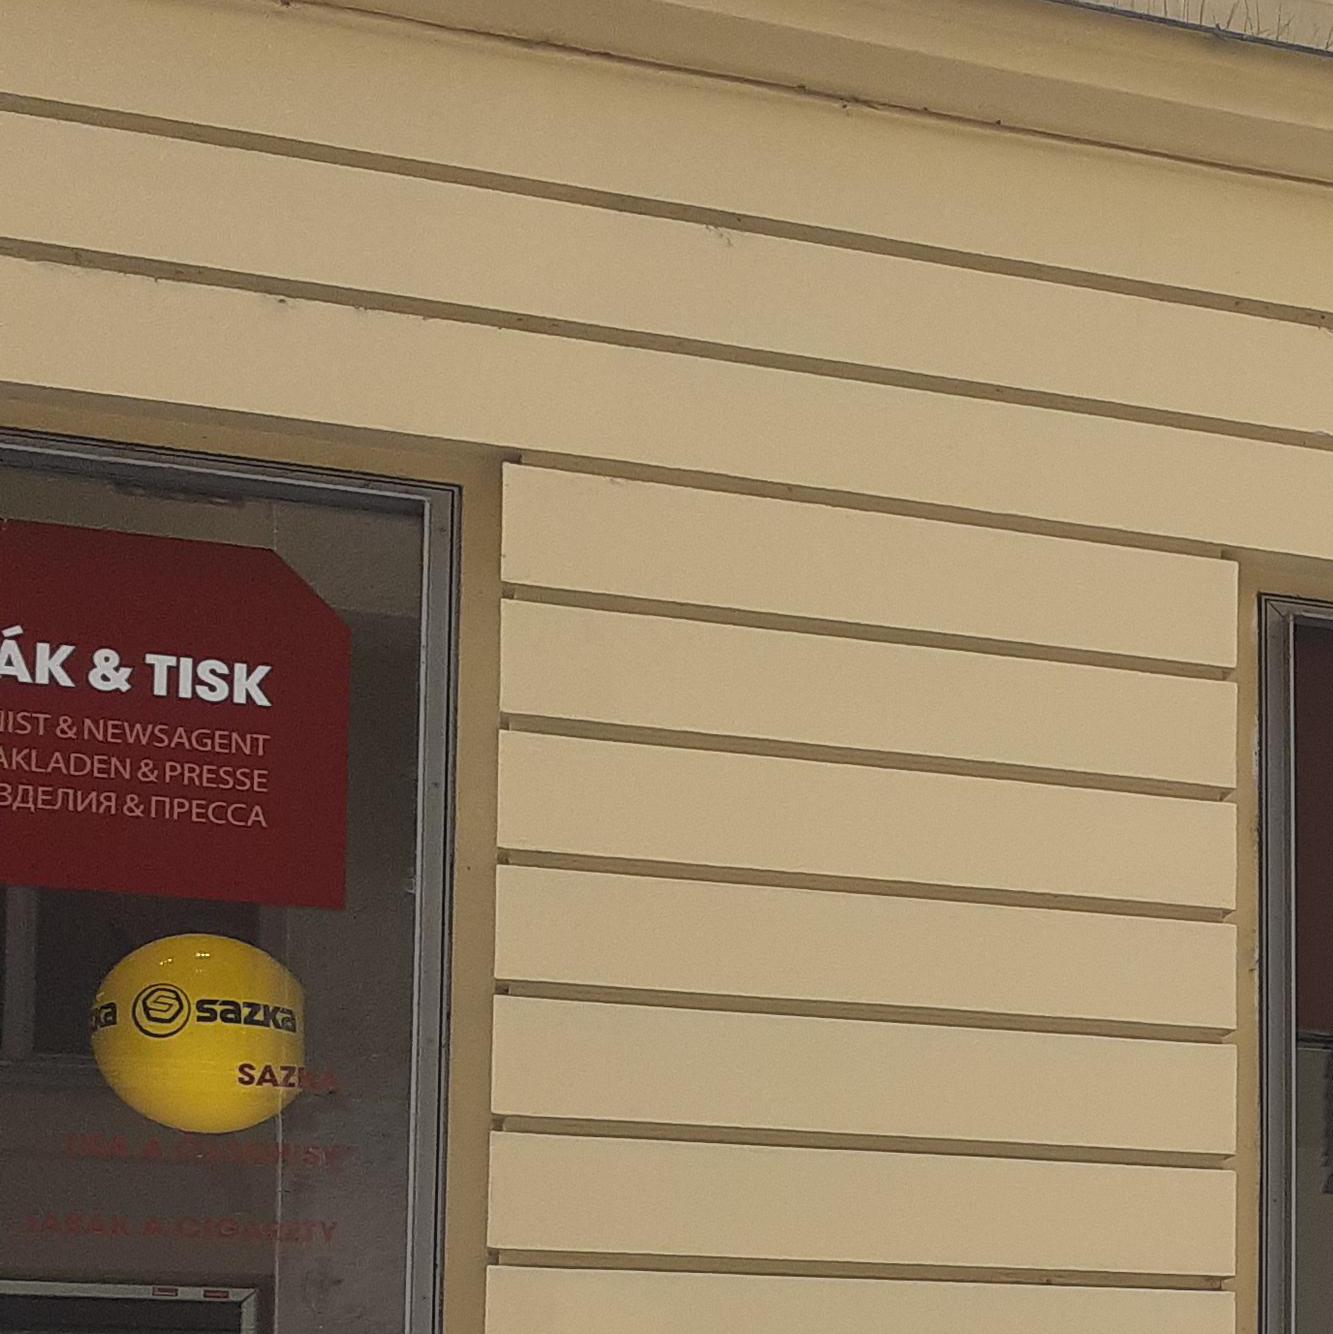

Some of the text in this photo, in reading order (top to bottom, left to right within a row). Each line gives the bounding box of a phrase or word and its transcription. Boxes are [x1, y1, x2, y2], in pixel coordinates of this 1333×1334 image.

[88, 648, 133, 693] &
[145, 653, 272, 707] TISK
[55, 716, 77, 739] &
[84, 718, 271, 756] NEWSAGENT
[137, 759, 159, 783] &
[165, 761, 269, 792] PRESSE
[123, 793, 145, 818] &
[150, 796, 268, 828] ПРЕССА
